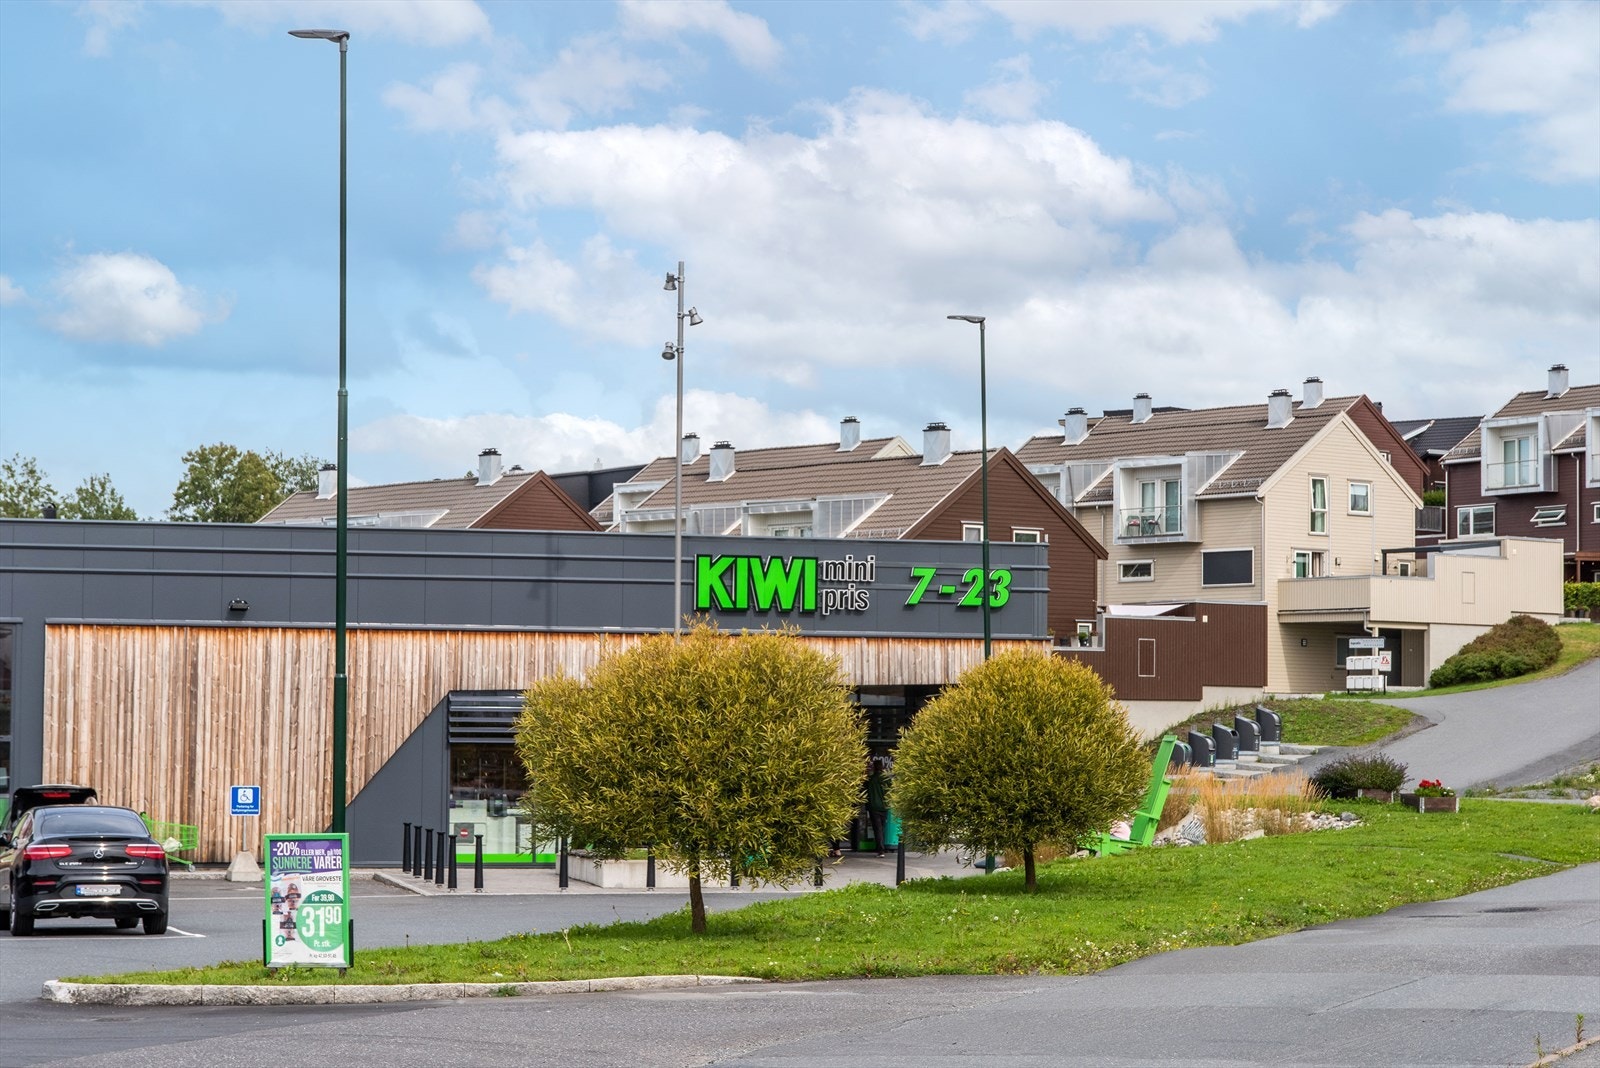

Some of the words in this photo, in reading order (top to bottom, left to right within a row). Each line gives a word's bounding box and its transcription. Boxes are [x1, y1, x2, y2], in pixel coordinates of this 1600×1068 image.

[823, 555, 875, 582] mini
[694, 554, 818, 612] KIWI
[822, 584, 870, 616] pris
[272, 842, 300, 856] -20%
[272, 857, 312, 869] SUNNERE
[314, 856, 342, 869] VARER
